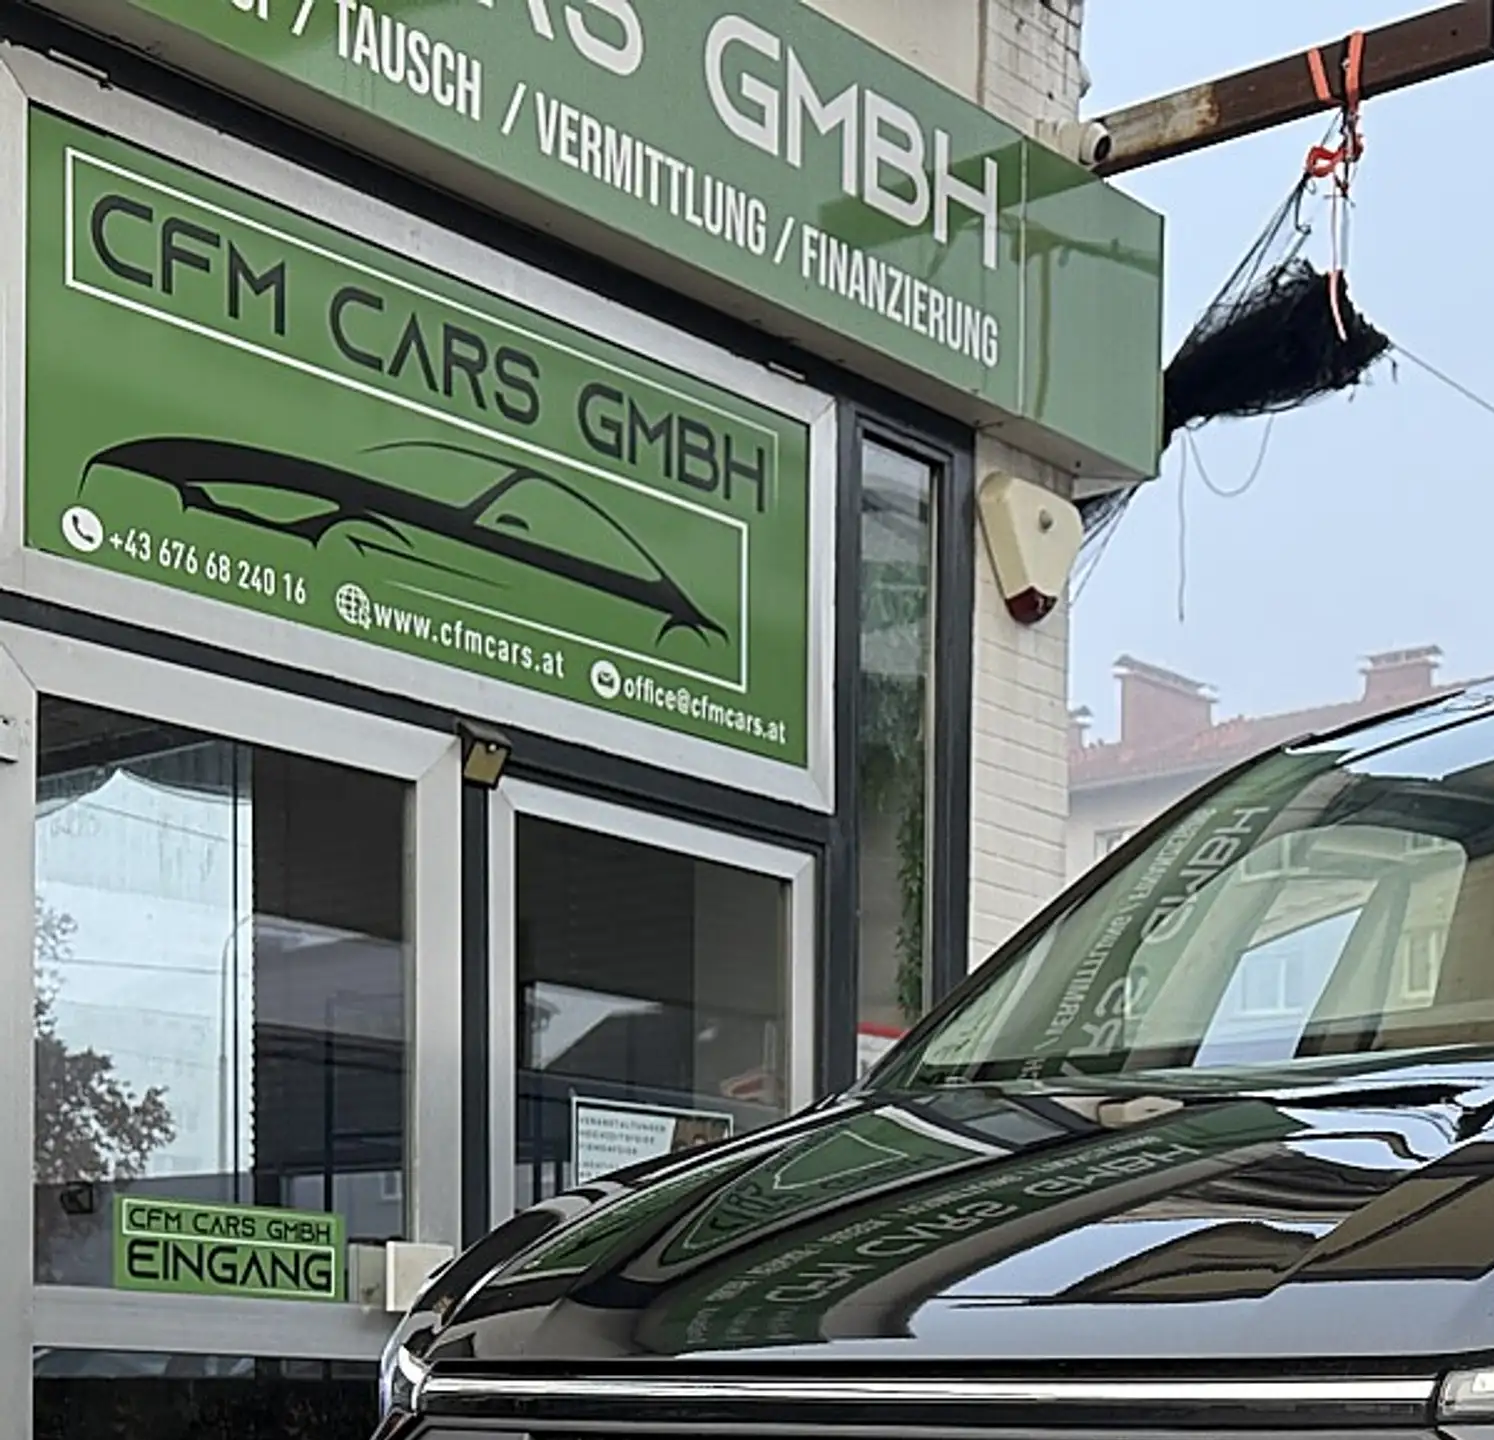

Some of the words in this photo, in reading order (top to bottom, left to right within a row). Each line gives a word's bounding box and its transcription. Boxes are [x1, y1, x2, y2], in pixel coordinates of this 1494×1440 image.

[705, 14, 998, 271] GMBH
[336, 0, 482, 121] TAUSCH
[535, 92, 767, 257] VERMITTLUNG
[802, 227, 1000, 368] FINANZIERUNG
[90, 194, 286, 336] CFM
[330, 286, 540, 426] CARS
[578, 382, 765, 513] GMBH
[108, 532, 151, 562] +43
[159, 539, 199, 575] 676
[205, 551, 231, 584] 68
[238, 562, 276, 597] 240
[283, 573, 306, 605] 16
[374, 602, 565, 679] www.cfmcars.at
[622, 674, 787, 745] office@cfmcars.at
[129, 1207, 182, 1231] CFM
[192, 1213, 256, 1238] CARS
[266, 1219, 331, 1245] GMBH
[127, 1238, 333, 1292] EINGANG
